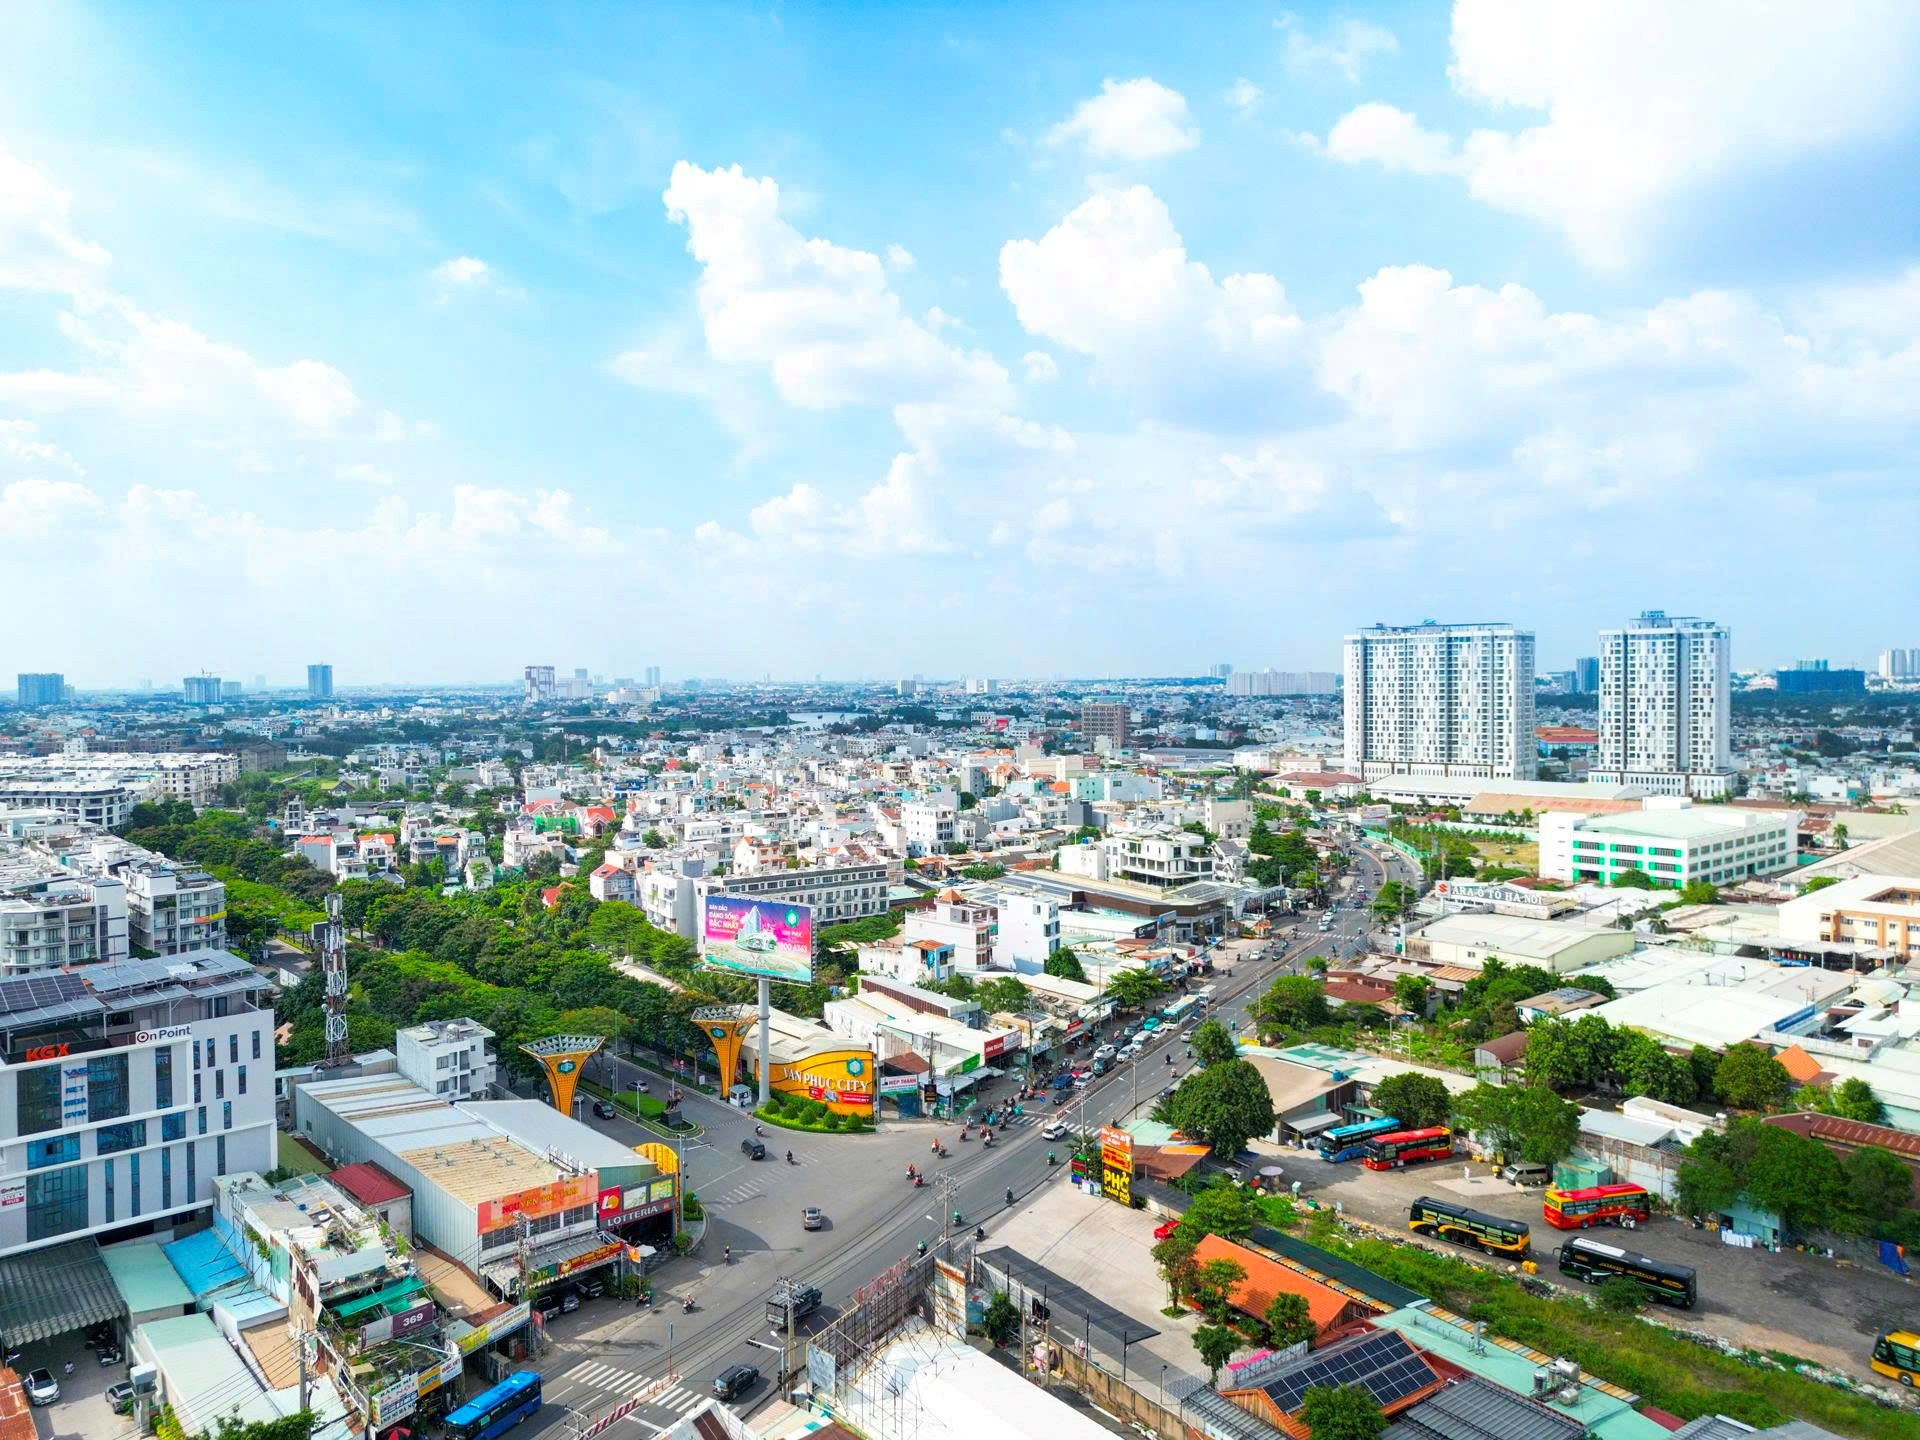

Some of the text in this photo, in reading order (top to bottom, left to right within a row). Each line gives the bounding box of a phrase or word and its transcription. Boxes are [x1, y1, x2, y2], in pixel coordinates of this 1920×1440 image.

[26, 1042, 71, 1062] KGX
[65, 1085, 85, 1094] NET
[837, 1078, 869, 1093] CITY
[64, 1109, 87, 1119] GYM
[1104, 1169, 1130, 1194] PHỞ
[607, 1205, 658, 1227] LOTTERIA
[402, 1312, 424, 1327] 369
